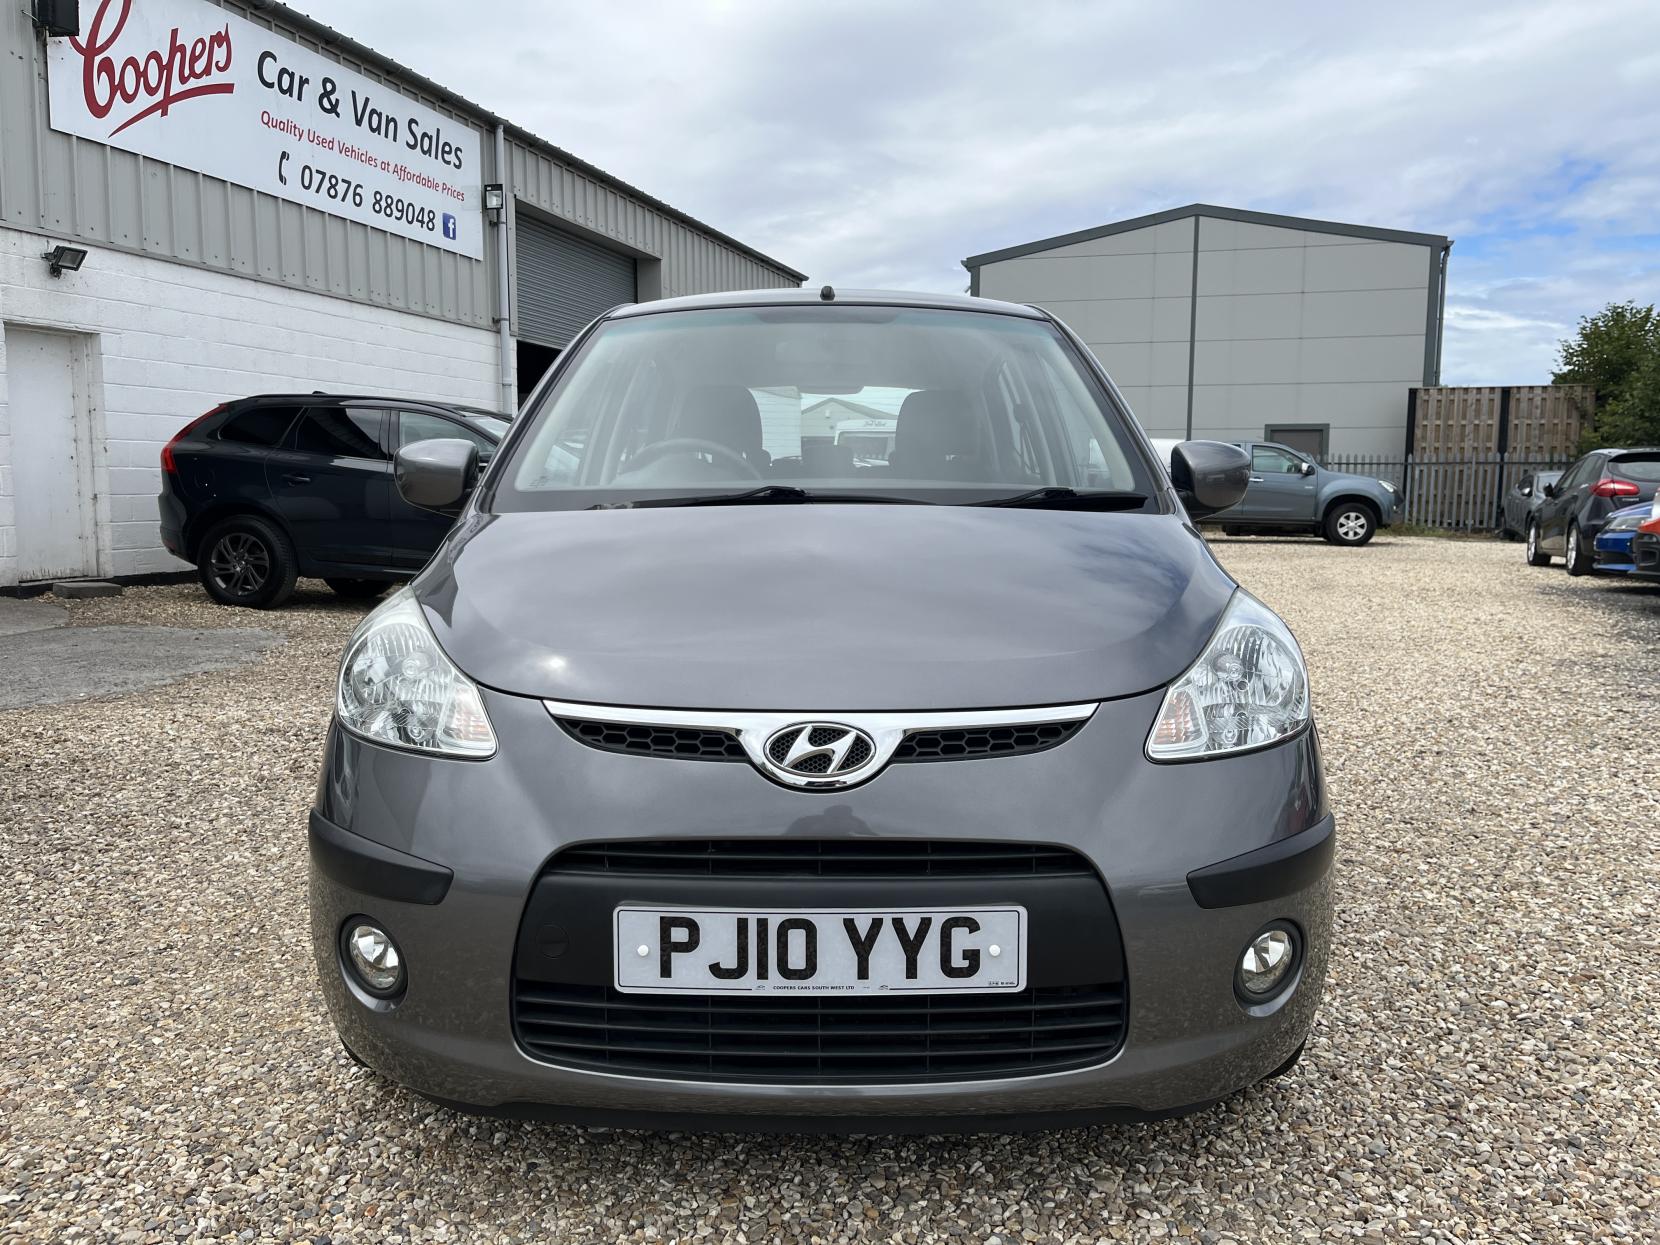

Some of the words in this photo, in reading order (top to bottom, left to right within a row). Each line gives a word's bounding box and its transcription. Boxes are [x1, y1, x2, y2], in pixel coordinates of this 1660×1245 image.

[69, 0, 233, 118] Coopers
[257, 50, 309, 102] Car
[318, 77, 341, 118] &
[351, 90, 398, 142] Van
[405, 117, 463, 170] Sales
[261, 110, 304, 142] Quality
[307, 129, 335, 151] Used
[337, 140, 378, 168] Vehicles
[380, 159, 391, 174] at
[392, 163, 440, 192] Affordable
[442, 182, 465, 202] Prices
[301, 164, 364, 208] 07876
[372, 190, 436, 232] 889048
[659, 916, 818, 981] PJ10
[842, 916, 982, 981] YYG
